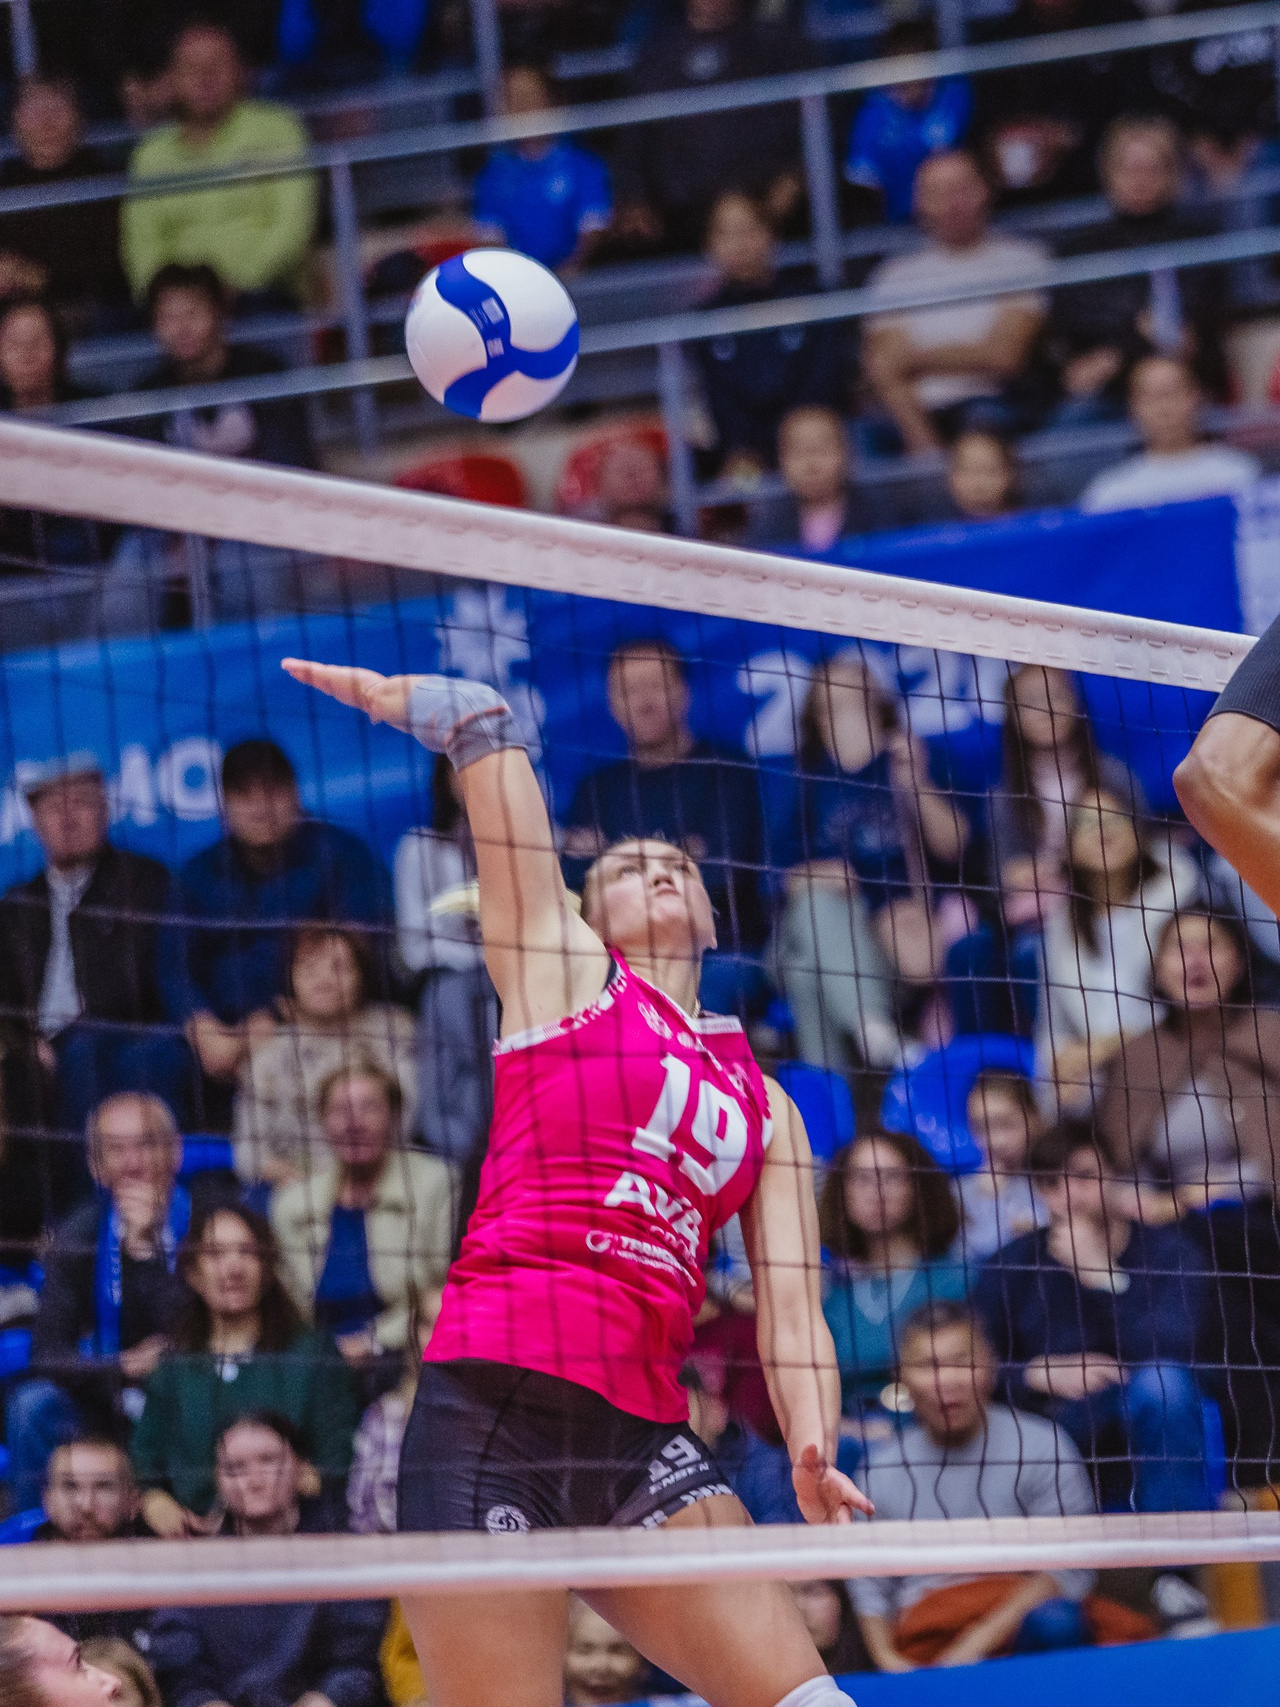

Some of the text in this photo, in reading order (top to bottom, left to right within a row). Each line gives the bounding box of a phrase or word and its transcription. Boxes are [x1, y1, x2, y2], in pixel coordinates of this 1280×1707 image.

[631, 1052, 748, 1196] 19
[603, 1171, 703, 1258] AVA
[648, 1434, 702, 1483] 19
